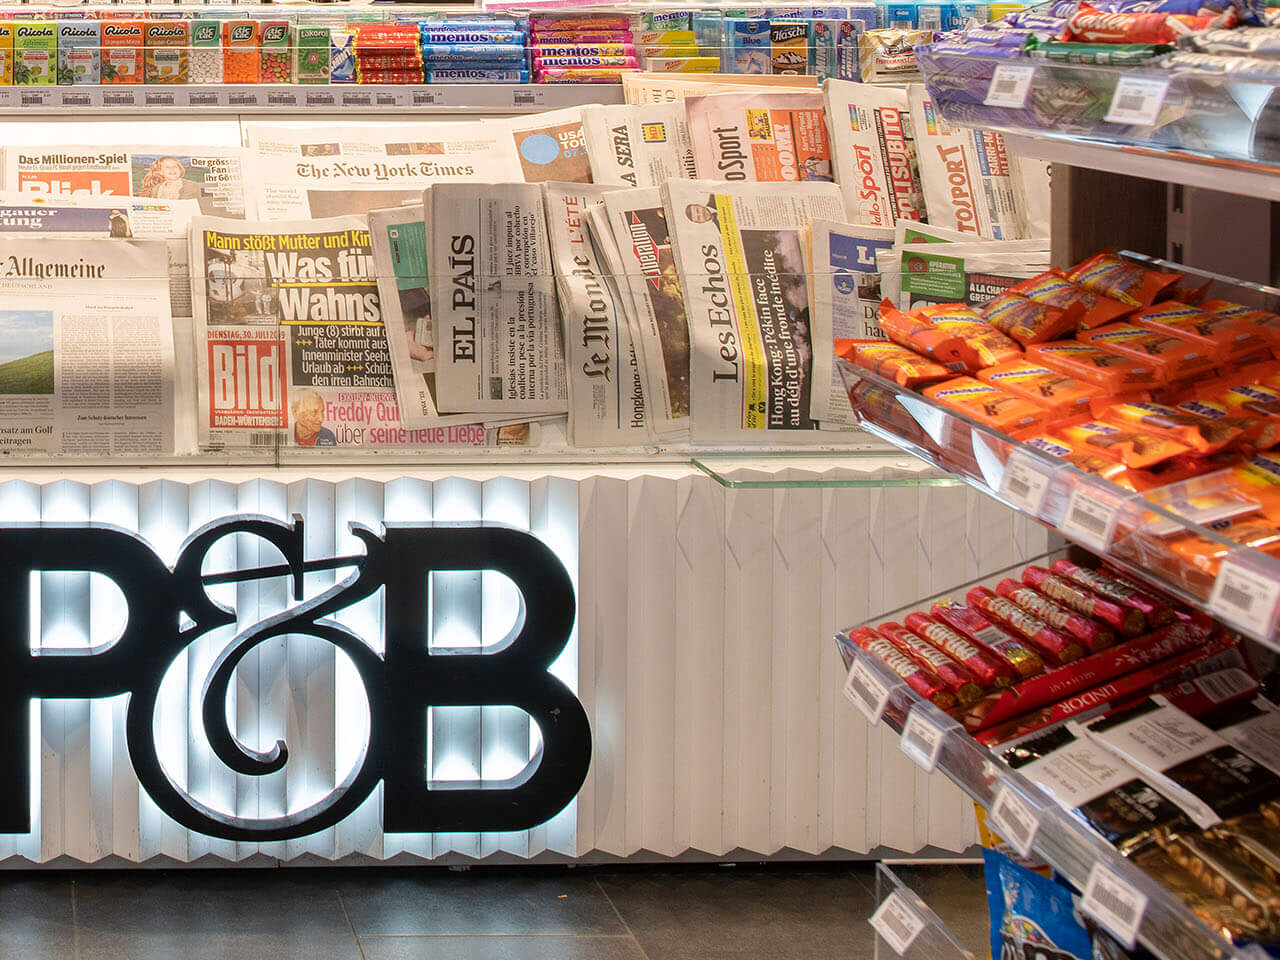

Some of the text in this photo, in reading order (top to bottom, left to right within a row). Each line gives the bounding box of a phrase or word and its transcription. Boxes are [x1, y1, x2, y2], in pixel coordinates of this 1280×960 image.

[18, 26, 54, 38] Ricola
[104, 26, 141, 36] Ricola
[431, 32, 488, 44] mentos
[773, 25, 807, 42] Haschi
[541, 45, 600, 57] mentos
[613, 124, 634, 169] SERA
[712, 126, 748, 170] Sport
[18, 154, 128, 166] Das Millionen-Spiel
[296, 161, 475, 181] The New York Times
[852, 144, 881, 201] Sport
[562, 196, 584, 244] L'ÉTÉ
[207, 232, 348, 250] Mann stößt Mutter und
[8, 255, 106, 279] Allgemeine
[266, 253, 333, 282] Was
[448, 234, 475, 364] EL PAÍS
[755, 278, 771, 305] face
[571, 254, 611, 383] Le Monde
[701, 243, 739, 383] Les Echos
[759, 306, 777, 343] Pékin
[297, 326, 381, 338] Junge (8) stirbt auf
[762, 249, 800, 426] au défi d'une fronde inédite
[302, 349, 363, 361] Innenminister
[213, 344, 282, 411] Bild
[302, 362, 344, 374] Urlaub ab
[311, 374, 351, 386] den irren
[326, 400, 371, 423] Freddy
[770, 387, 786, 426] Hong
[35, 426, 53, 435] Golf
[336, 426, 365, 444] über
[370, 426, 406, 444] seine
[447, 425, 485, 444] Liebe
[1060, 683, 1117, 714] LINDOR
